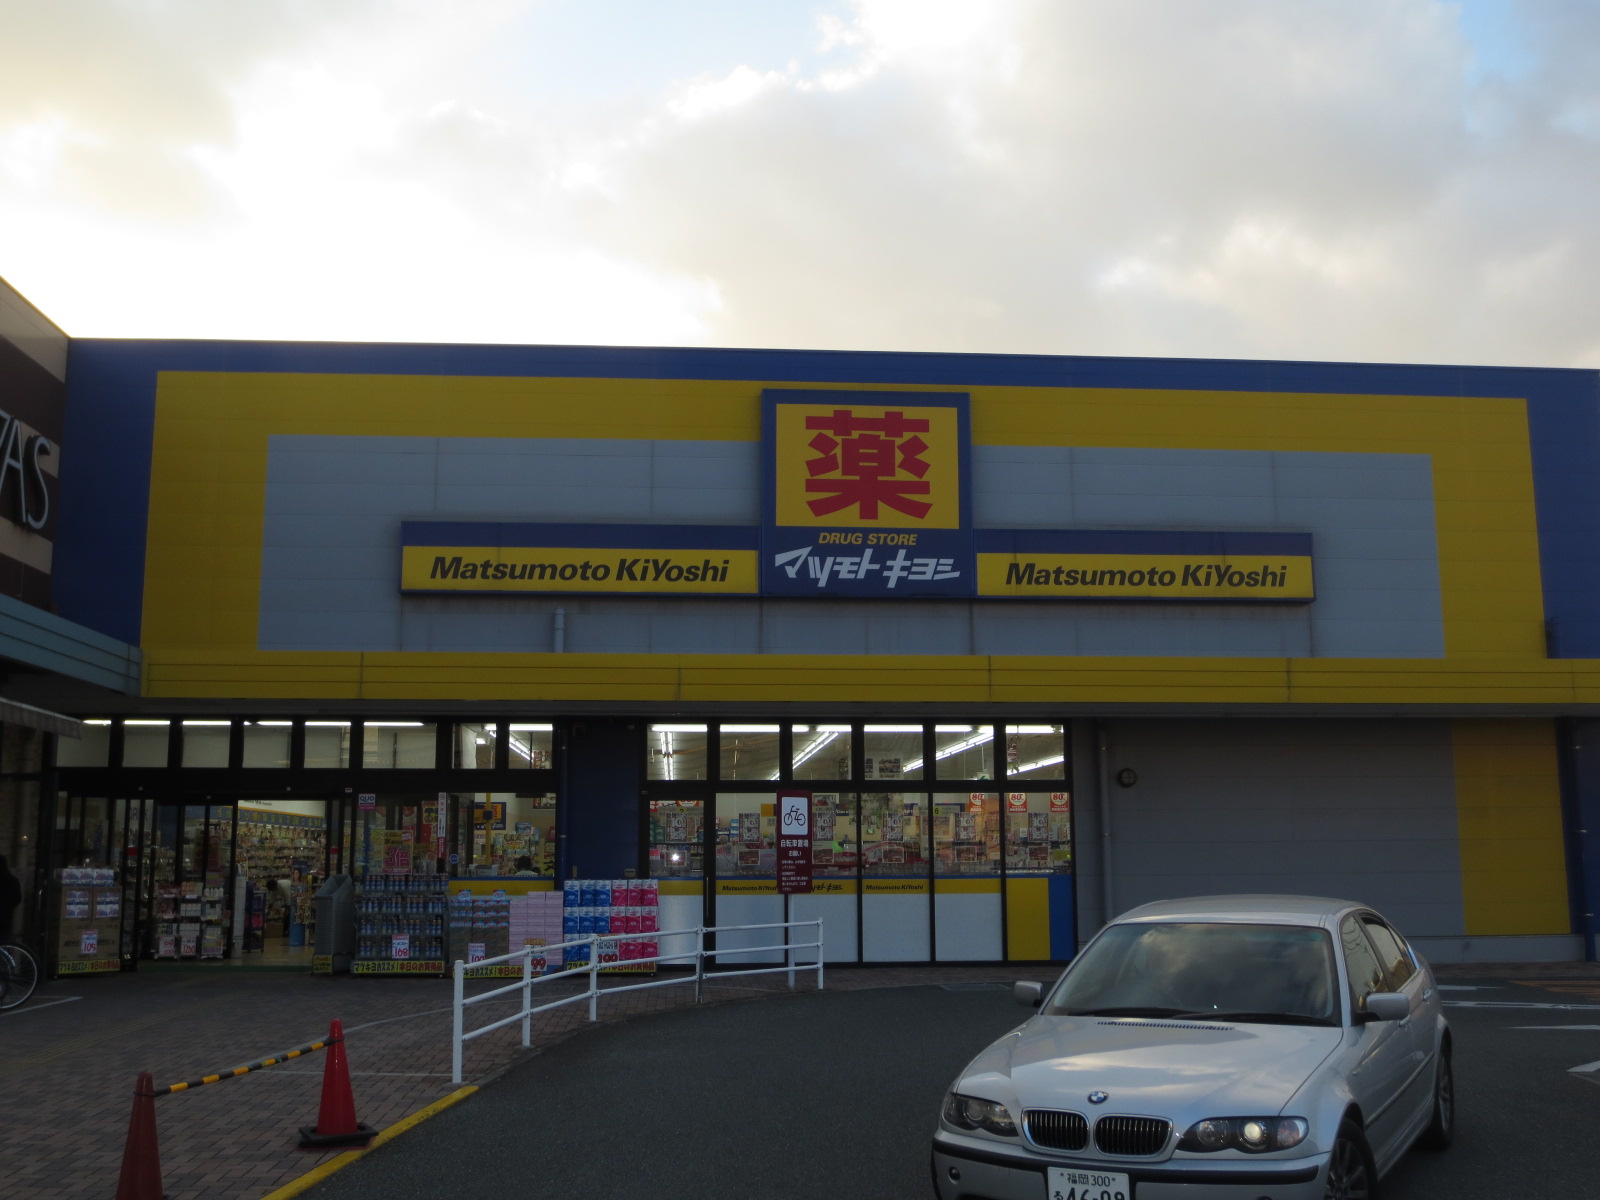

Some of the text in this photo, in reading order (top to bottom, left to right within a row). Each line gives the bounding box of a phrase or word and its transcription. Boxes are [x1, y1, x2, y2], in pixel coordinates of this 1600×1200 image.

[805, 409, 933, 520] 薬
[818, 532, 918, 546] DRUG STORE
[430, 556, 730, 582] Matsumoto KiYoshi
[1006, 562, 1287, 588] Matsumoto KiYoshi
[780, 839, 808, 848] 自転車置場
[531, 957, 546, 970] 99
